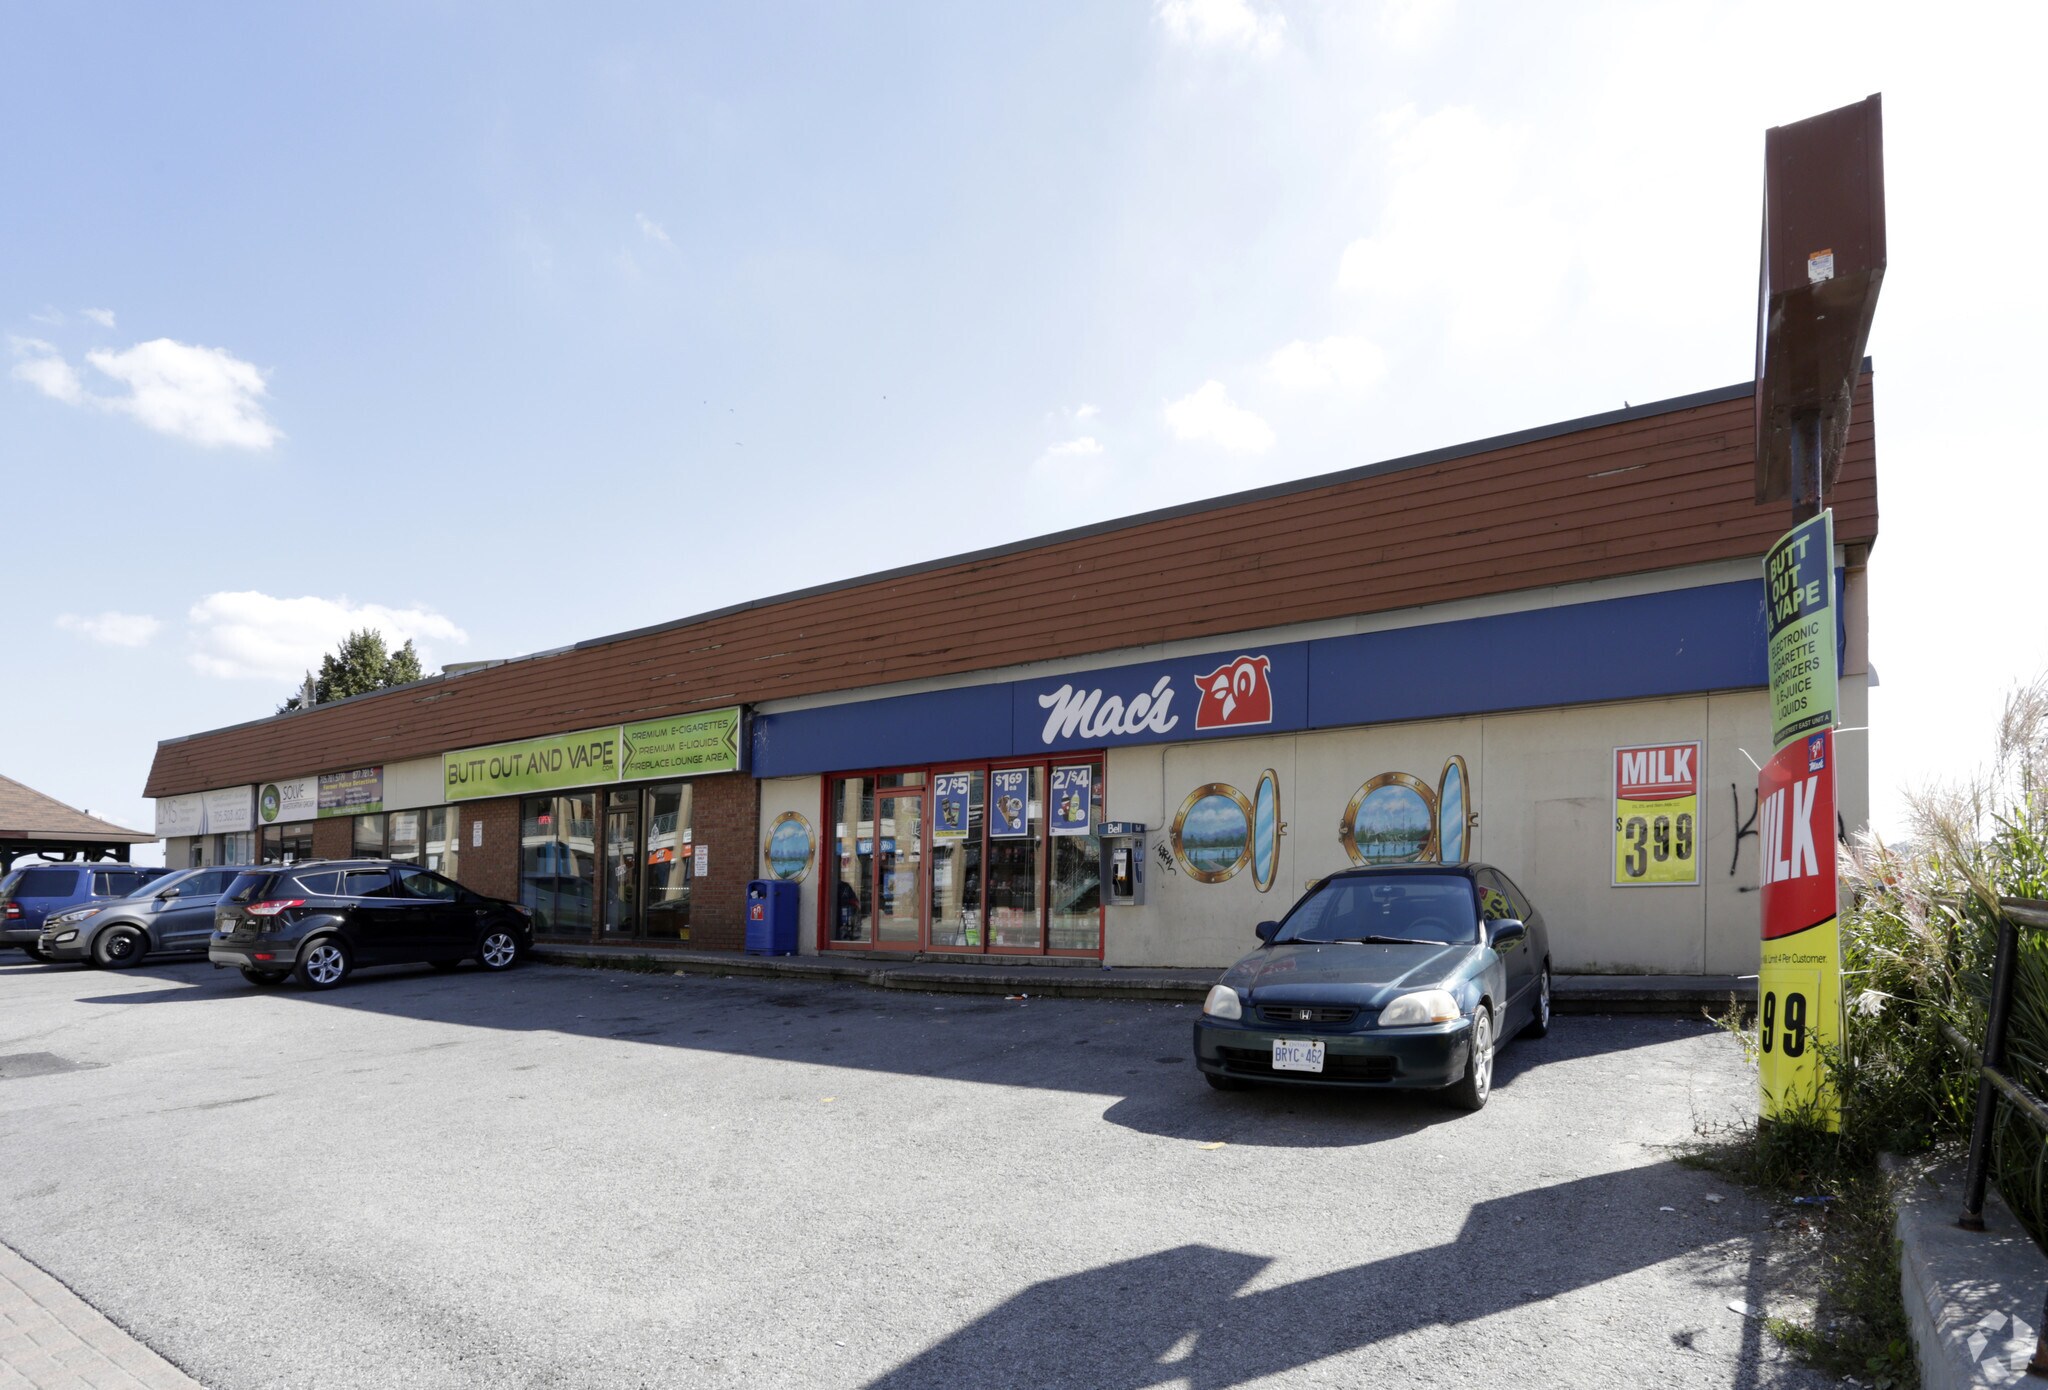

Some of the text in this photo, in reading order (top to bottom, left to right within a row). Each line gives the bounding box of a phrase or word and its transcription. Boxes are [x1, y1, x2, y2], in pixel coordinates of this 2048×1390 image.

[1770, 534, 1810, 582] BUTT
[1773, 564, 1801, 603] OUT
[1775, 580, 1820, 623] VAPE
[1771, 622, 1819, 660] ELECTRONIC
[1773, 641, 1816, 674] CIGARETTE
[1774, 657, 1820, 691] VAPORIZERS
[1780, 677, 1812, 703] E-JUICE
[1038, 675, 1179, 745] Mac's
[1779, 696, 1808, 720] LIQUIDS
[631, 719, 729, 740] PREMIUM E-CIGARETTES
[1798, 720, 1811, 728] EAST
[638, 737, 719, 755] PREMIUM E-LIQUIDS
[448, 740, 614, 785] BUTT OUT AND VAPE
[630, 752, 729, 771] FIREPLACE LOUNGE AREA
[1622, 748, 1692, 785] MILK
[936, 777, 968, 796] 2/$5
[1053, 769, 1089, 789] 2/$4
[282, 783, 305, 801] SOLVE
[1107, 823, 1122, 833] Bell
[1782, 953, 1791, 963] Per
[1792, 953, 1828, 964] Customer.
